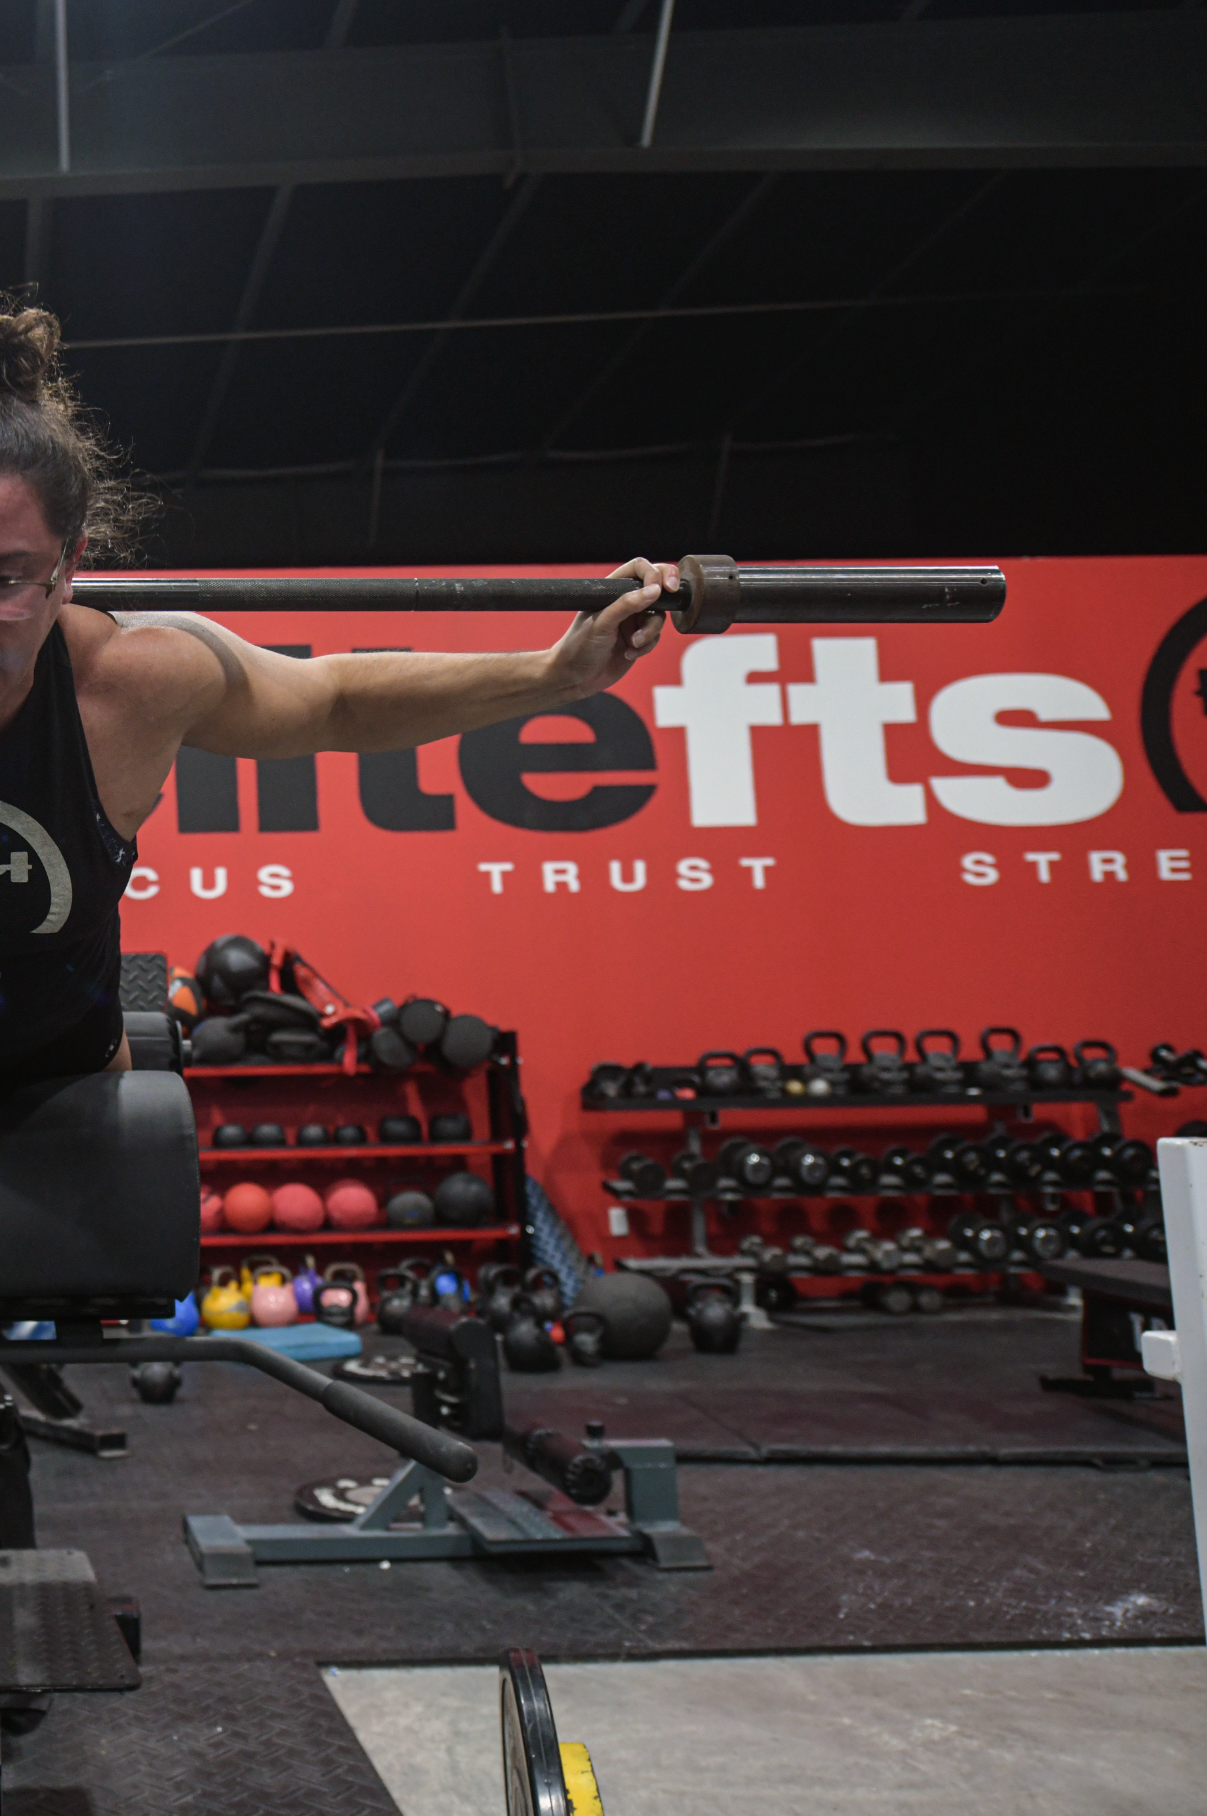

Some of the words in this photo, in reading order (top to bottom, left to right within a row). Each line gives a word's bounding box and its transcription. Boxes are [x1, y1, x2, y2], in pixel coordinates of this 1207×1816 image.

[154, 633, 1125, 833] efts
[477, 857, 778, 894] TRUST
[961, 849, 1194, 886] STRE
